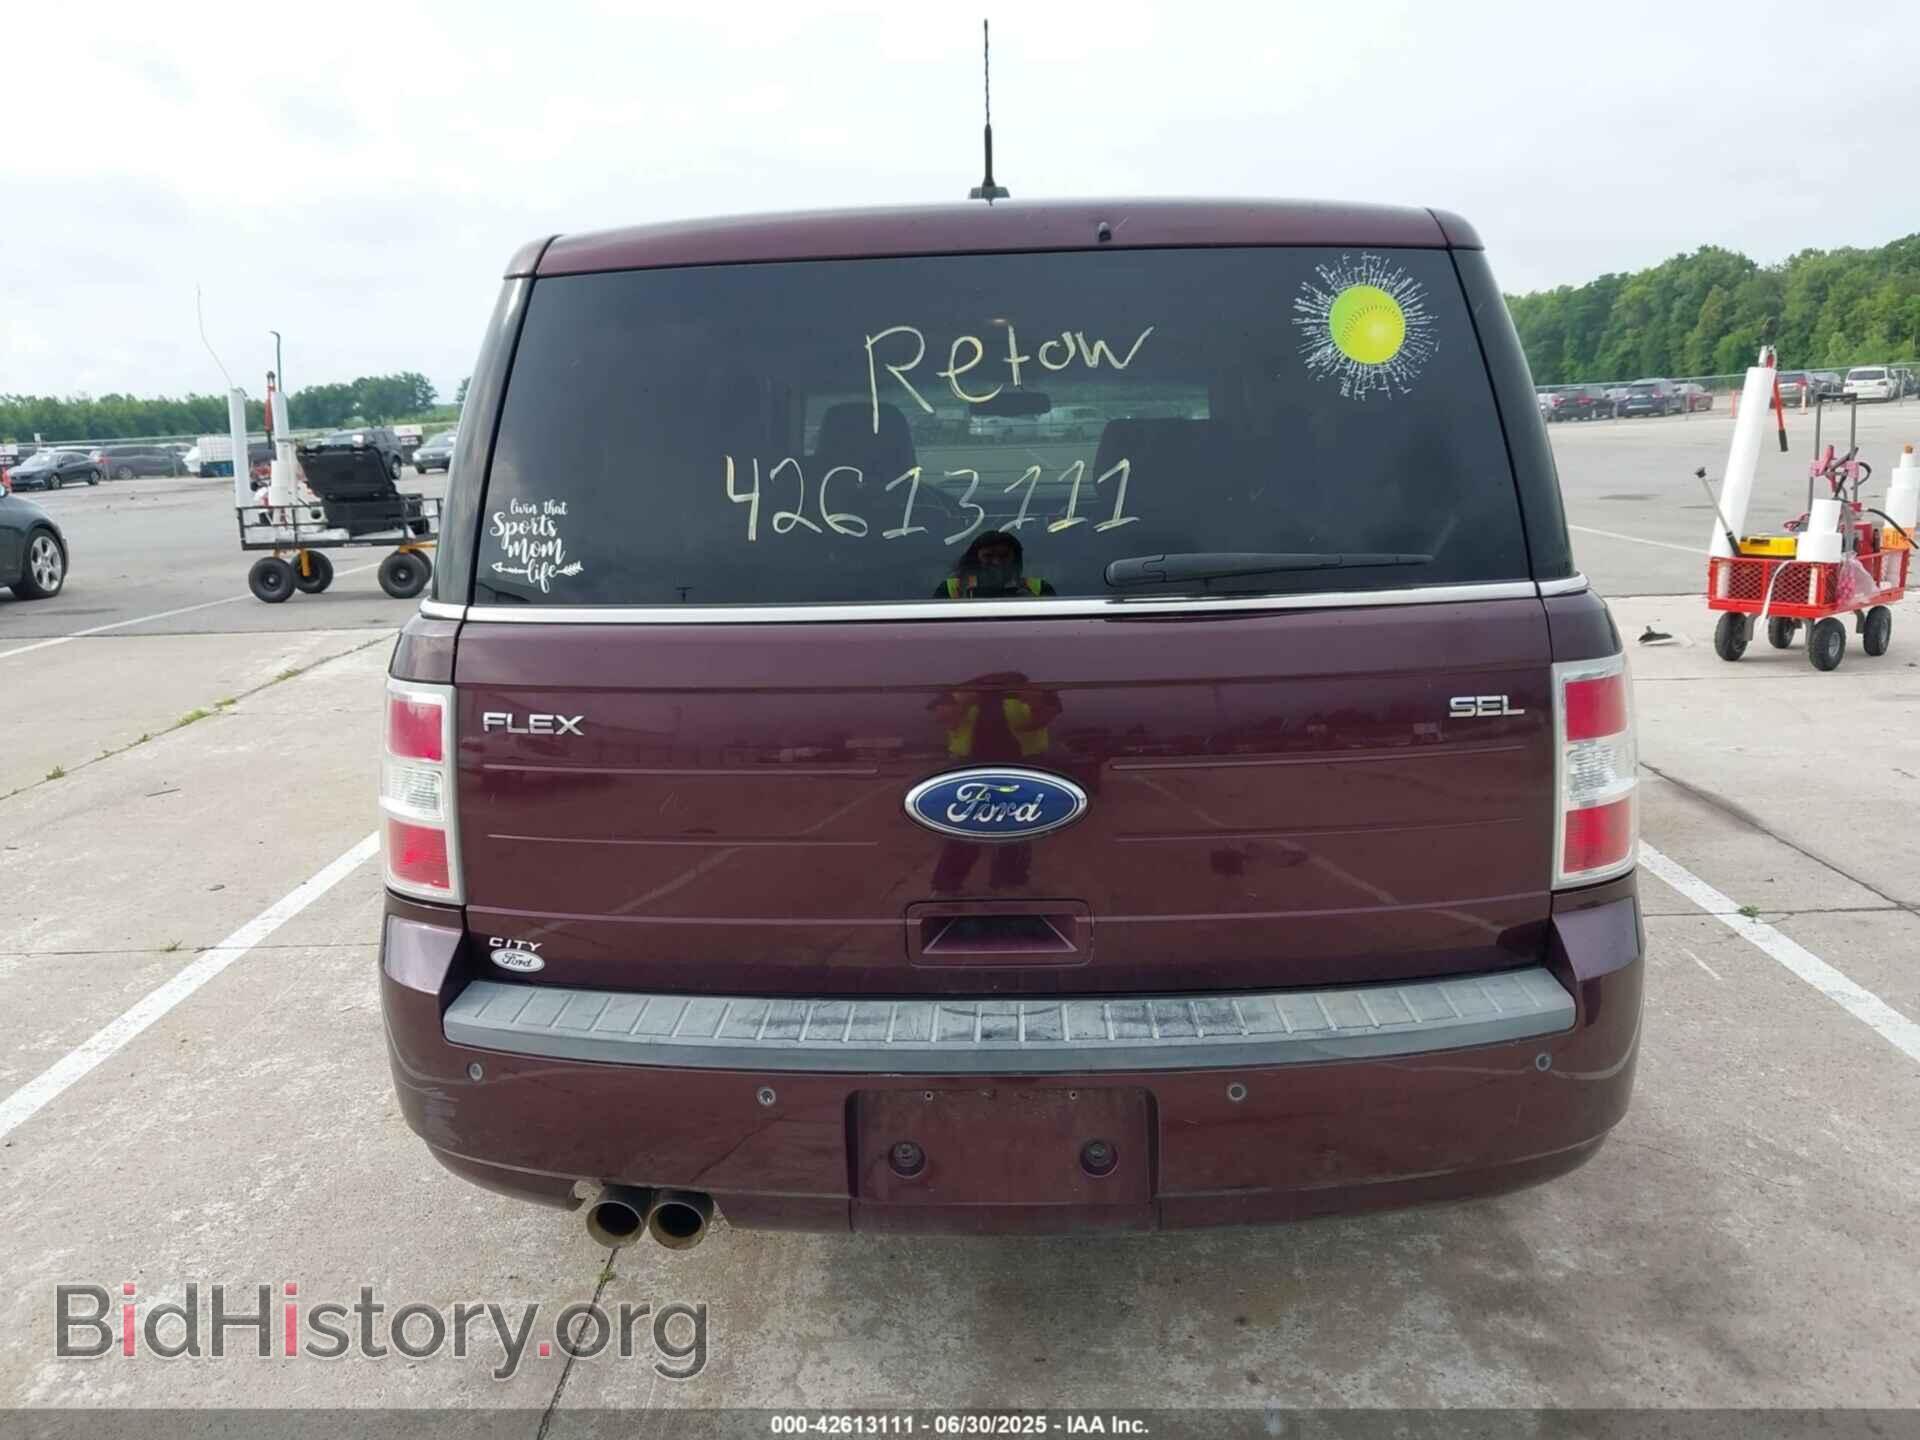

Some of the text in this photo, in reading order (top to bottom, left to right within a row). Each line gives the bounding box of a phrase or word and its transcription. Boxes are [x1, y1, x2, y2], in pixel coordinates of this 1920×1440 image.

[543, 499, 568, 516] that
[725, 455, 1141, 545] 42613111
[489, 511, 559, 550] Sports
[527, 558, 559, 594] life
[1448, 694, 1526, 718] SEL
[482, 711, 585, 736] FLEX
[946, 782, 1045, 823] Ford
[488, 936, 544, 952] CITY
[502, 952, 533, 968] Ford
